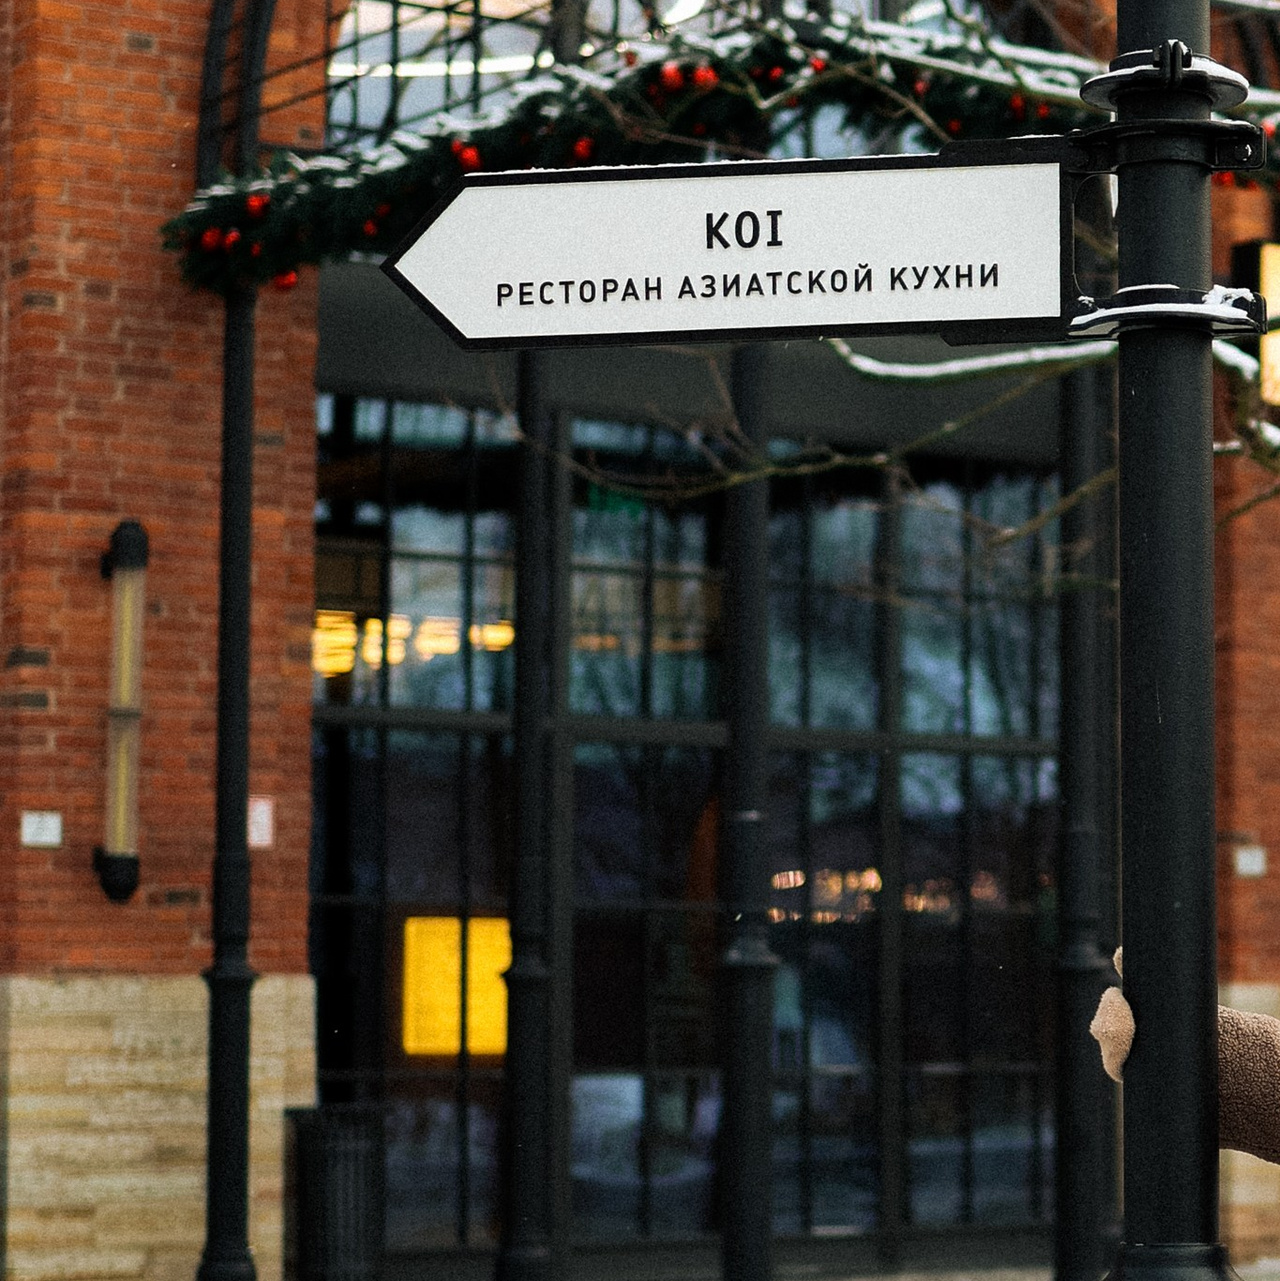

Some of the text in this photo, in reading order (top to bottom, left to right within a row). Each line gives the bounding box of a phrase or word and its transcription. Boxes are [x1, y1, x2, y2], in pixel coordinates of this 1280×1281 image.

[704, 209, 784, 251] KOI
[496, 261, 1000, 308] РЕСТОРАН АЗИАТСКОЙ КУХНИ
